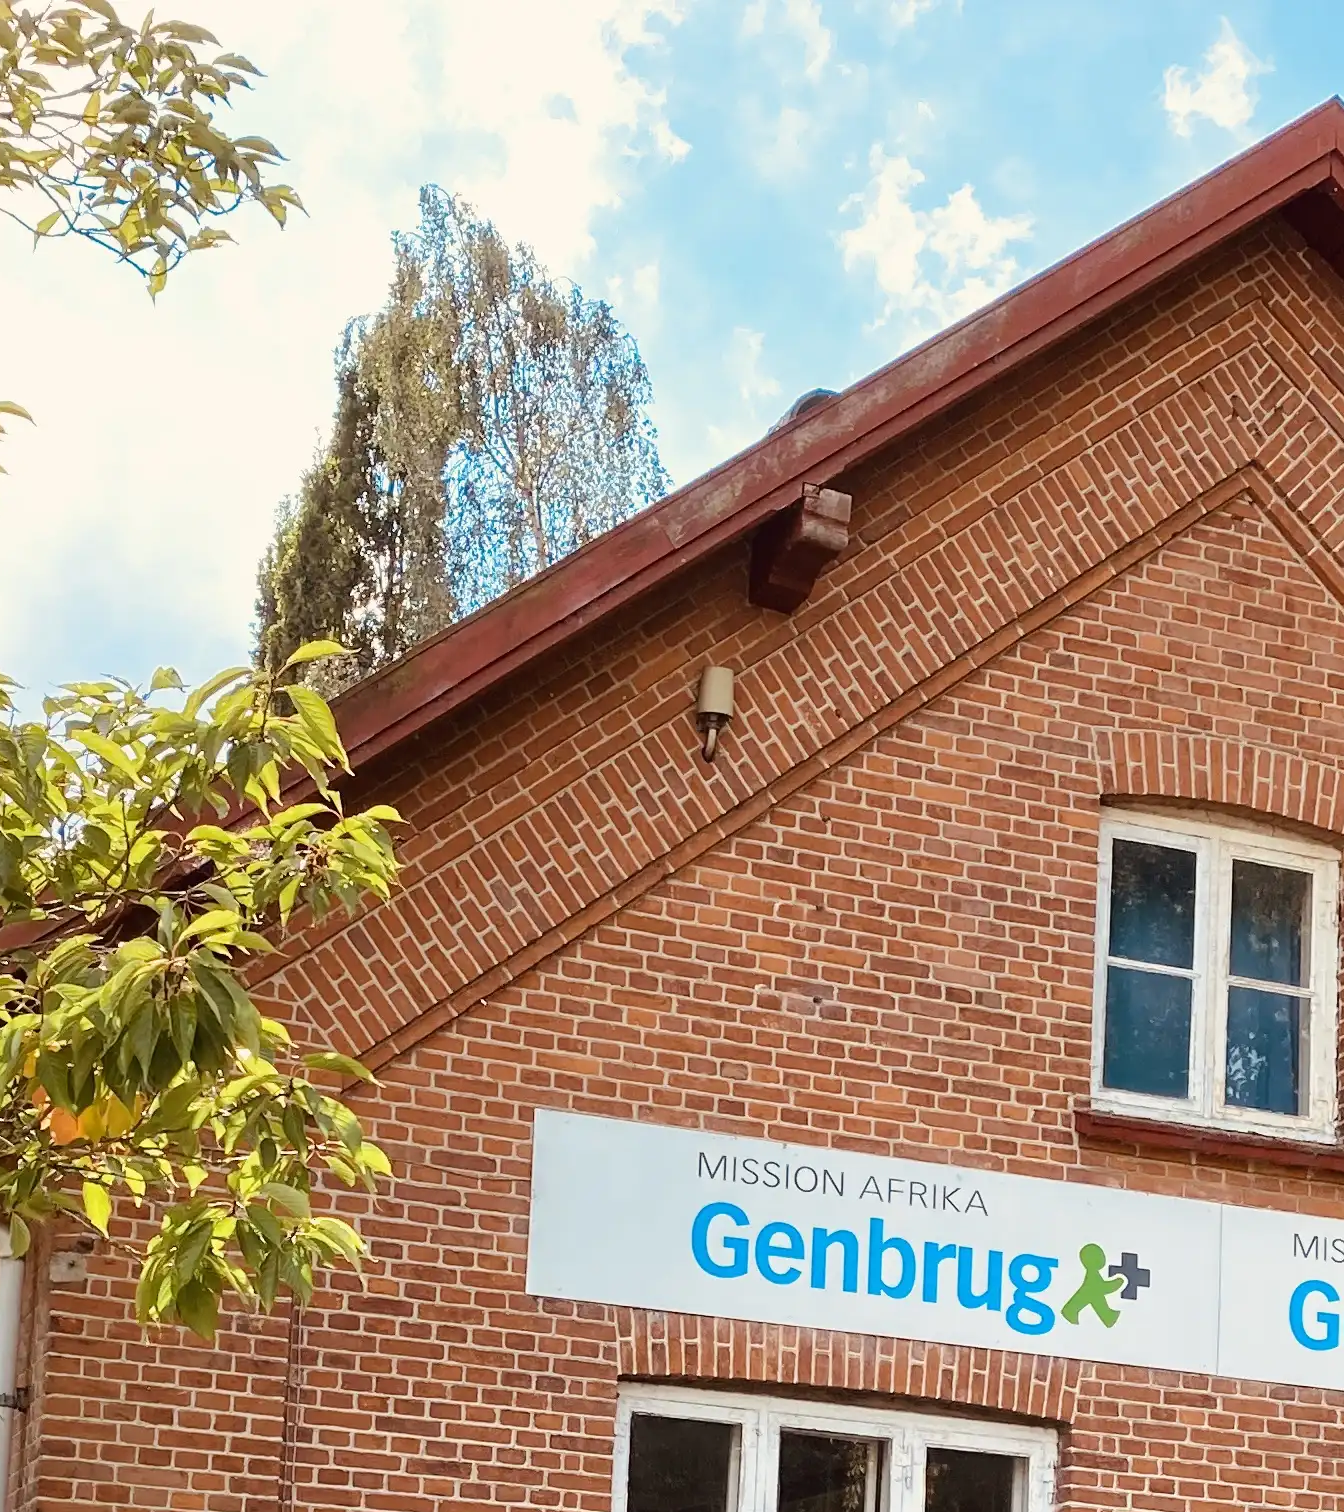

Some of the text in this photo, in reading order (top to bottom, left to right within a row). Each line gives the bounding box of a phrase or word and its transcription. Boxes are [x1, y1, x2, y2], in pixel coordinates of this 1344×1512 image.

[697, 1150, 990, 1218] MISSION AFRIKA
[690, 1201, 1060, 1336] Genbrug
